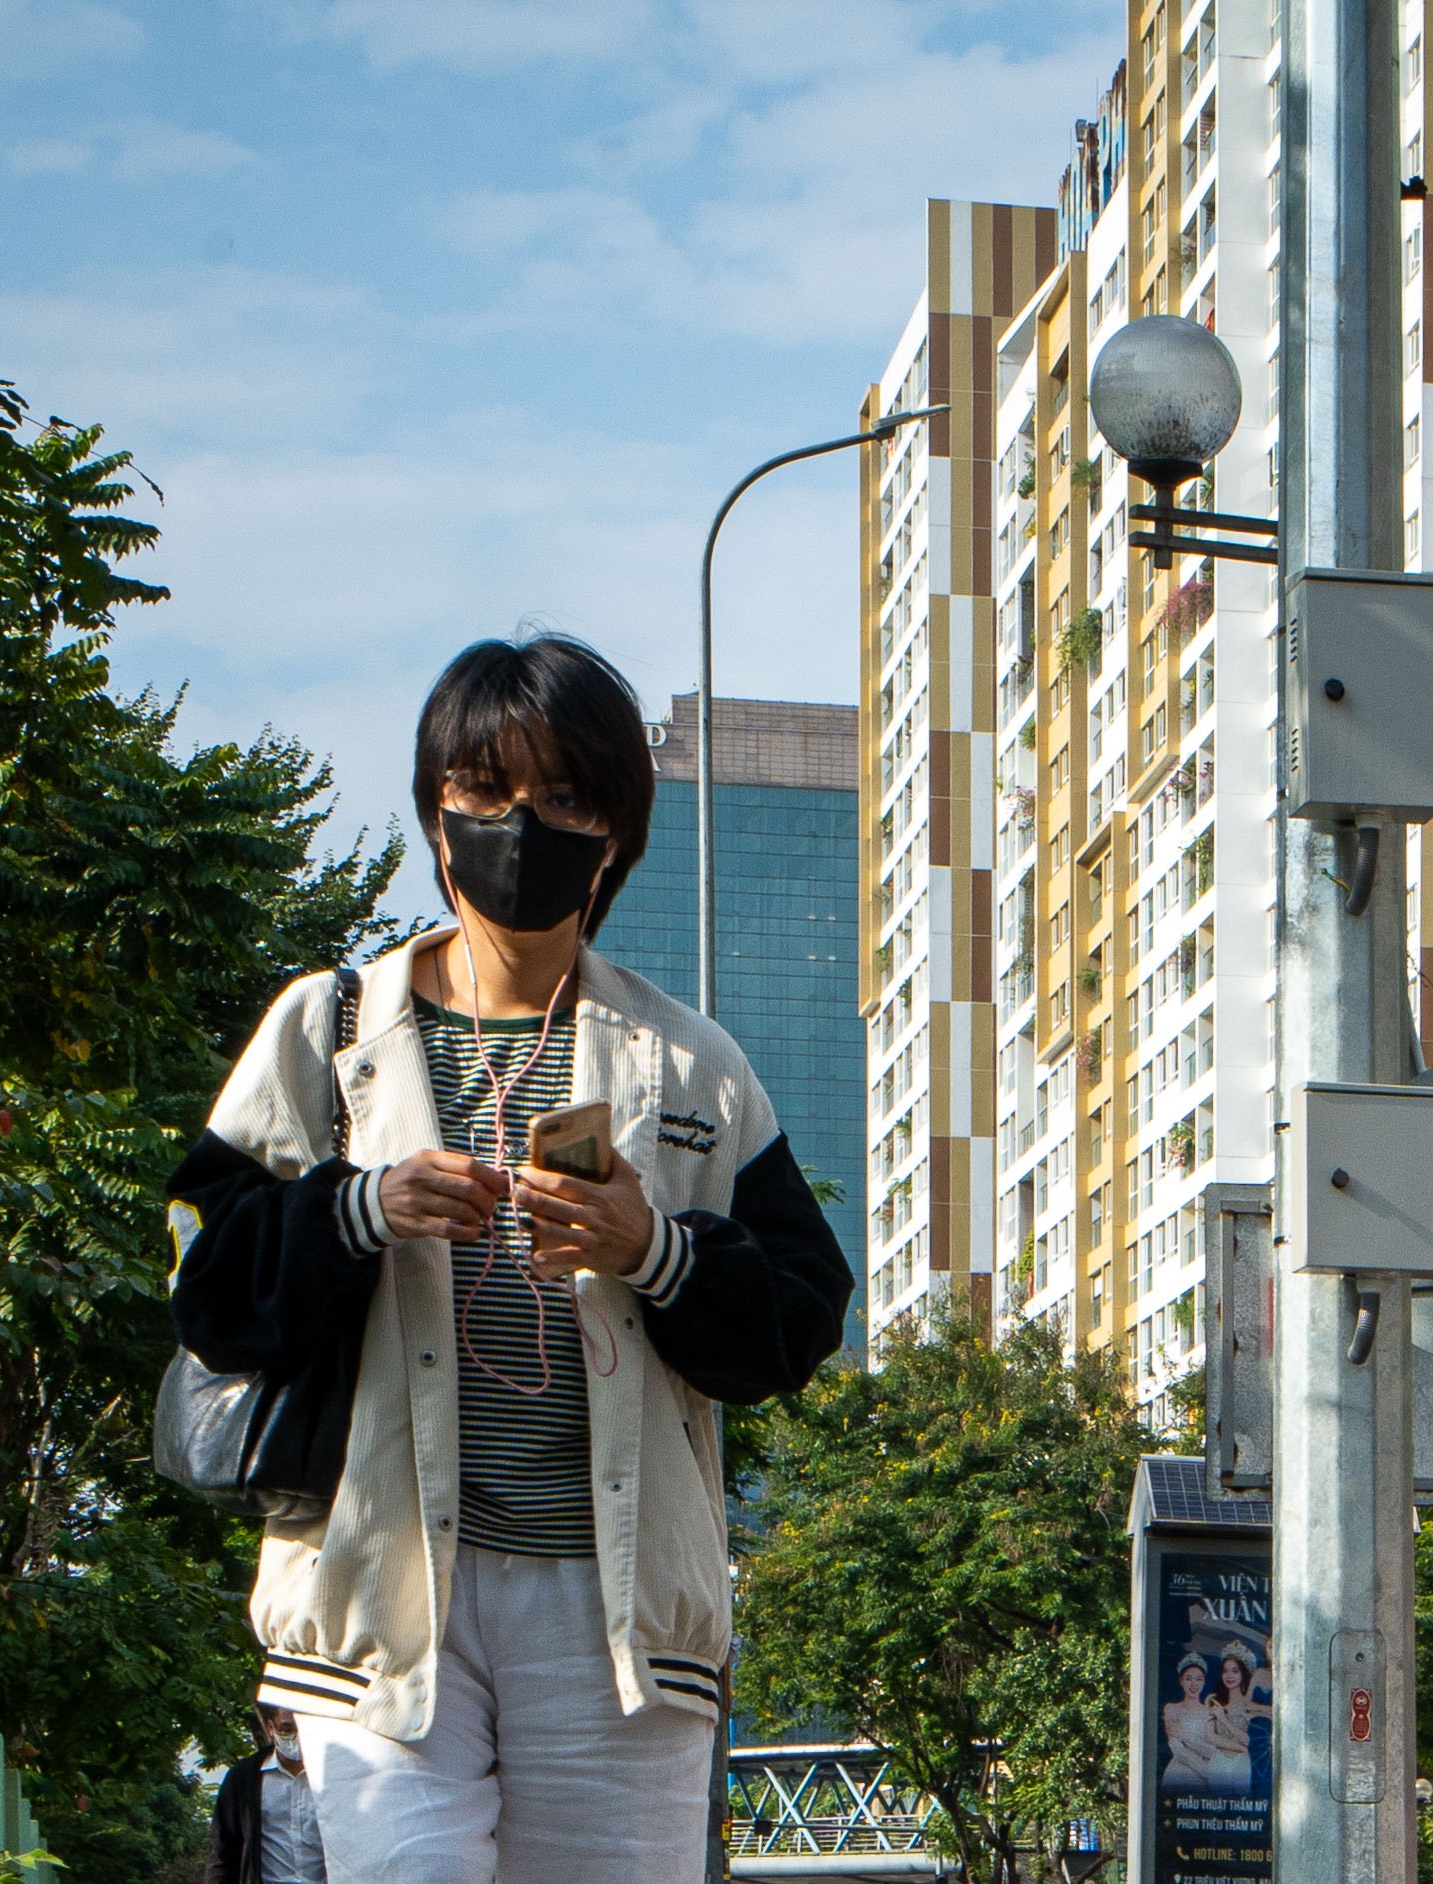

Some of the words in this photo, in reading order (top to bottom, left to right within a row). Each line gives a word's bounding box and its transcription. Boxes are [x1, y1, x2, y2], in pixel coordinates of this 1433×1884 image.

[1219, 1573, 1258, 1595] VIỆN
[1203, 1595, 1267, 1622] XUÂN
[1176, 1818, 1199, 1829] PHUN
[1194, 1848, 1236, 1860] HOTLINE:
